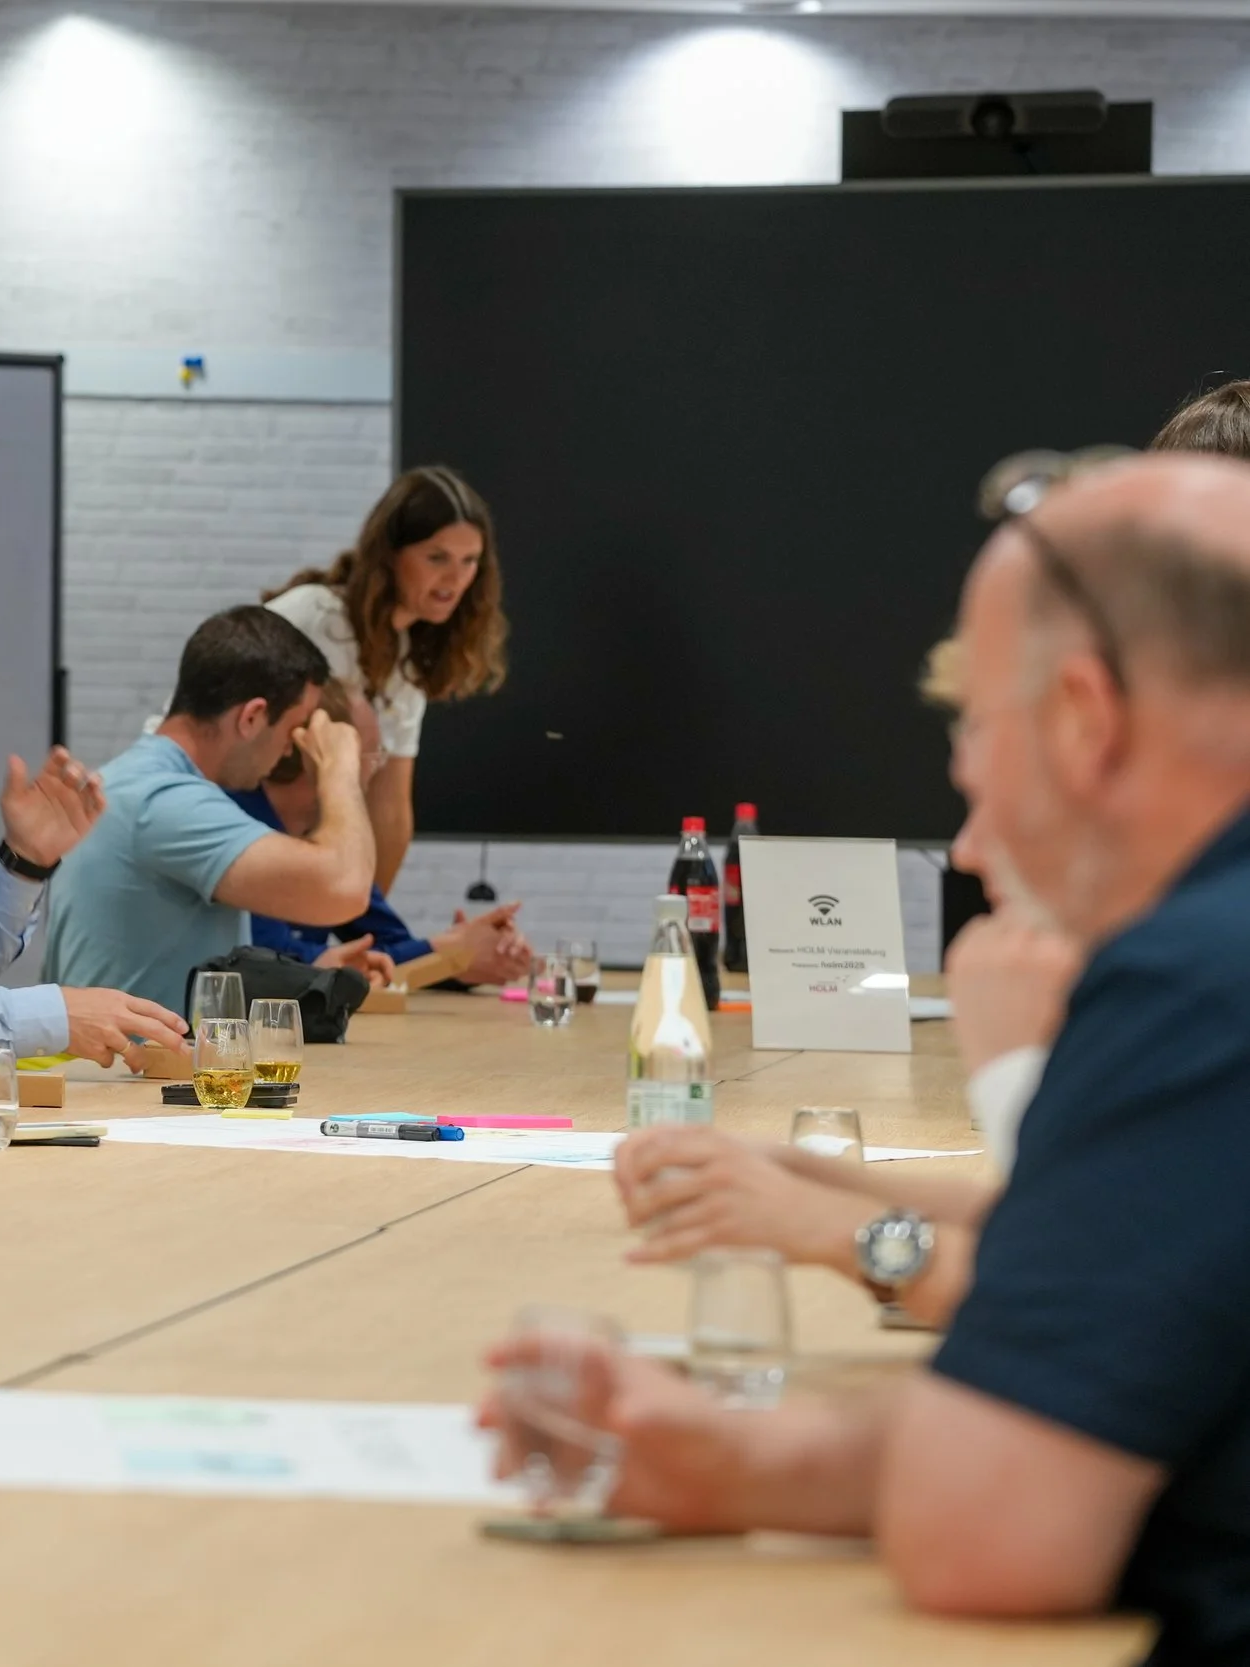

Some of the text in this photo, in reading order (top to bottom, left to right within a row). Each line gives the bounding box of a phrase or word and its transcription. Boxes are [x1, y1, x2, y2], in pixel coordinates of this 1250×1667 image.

[809, 917, 842, 926] WLAN
[796, 946, 825, 955] HOLM
[827, 946, 886, 957] Veranstaltung
[809, 984, 838, 993] HOLM
